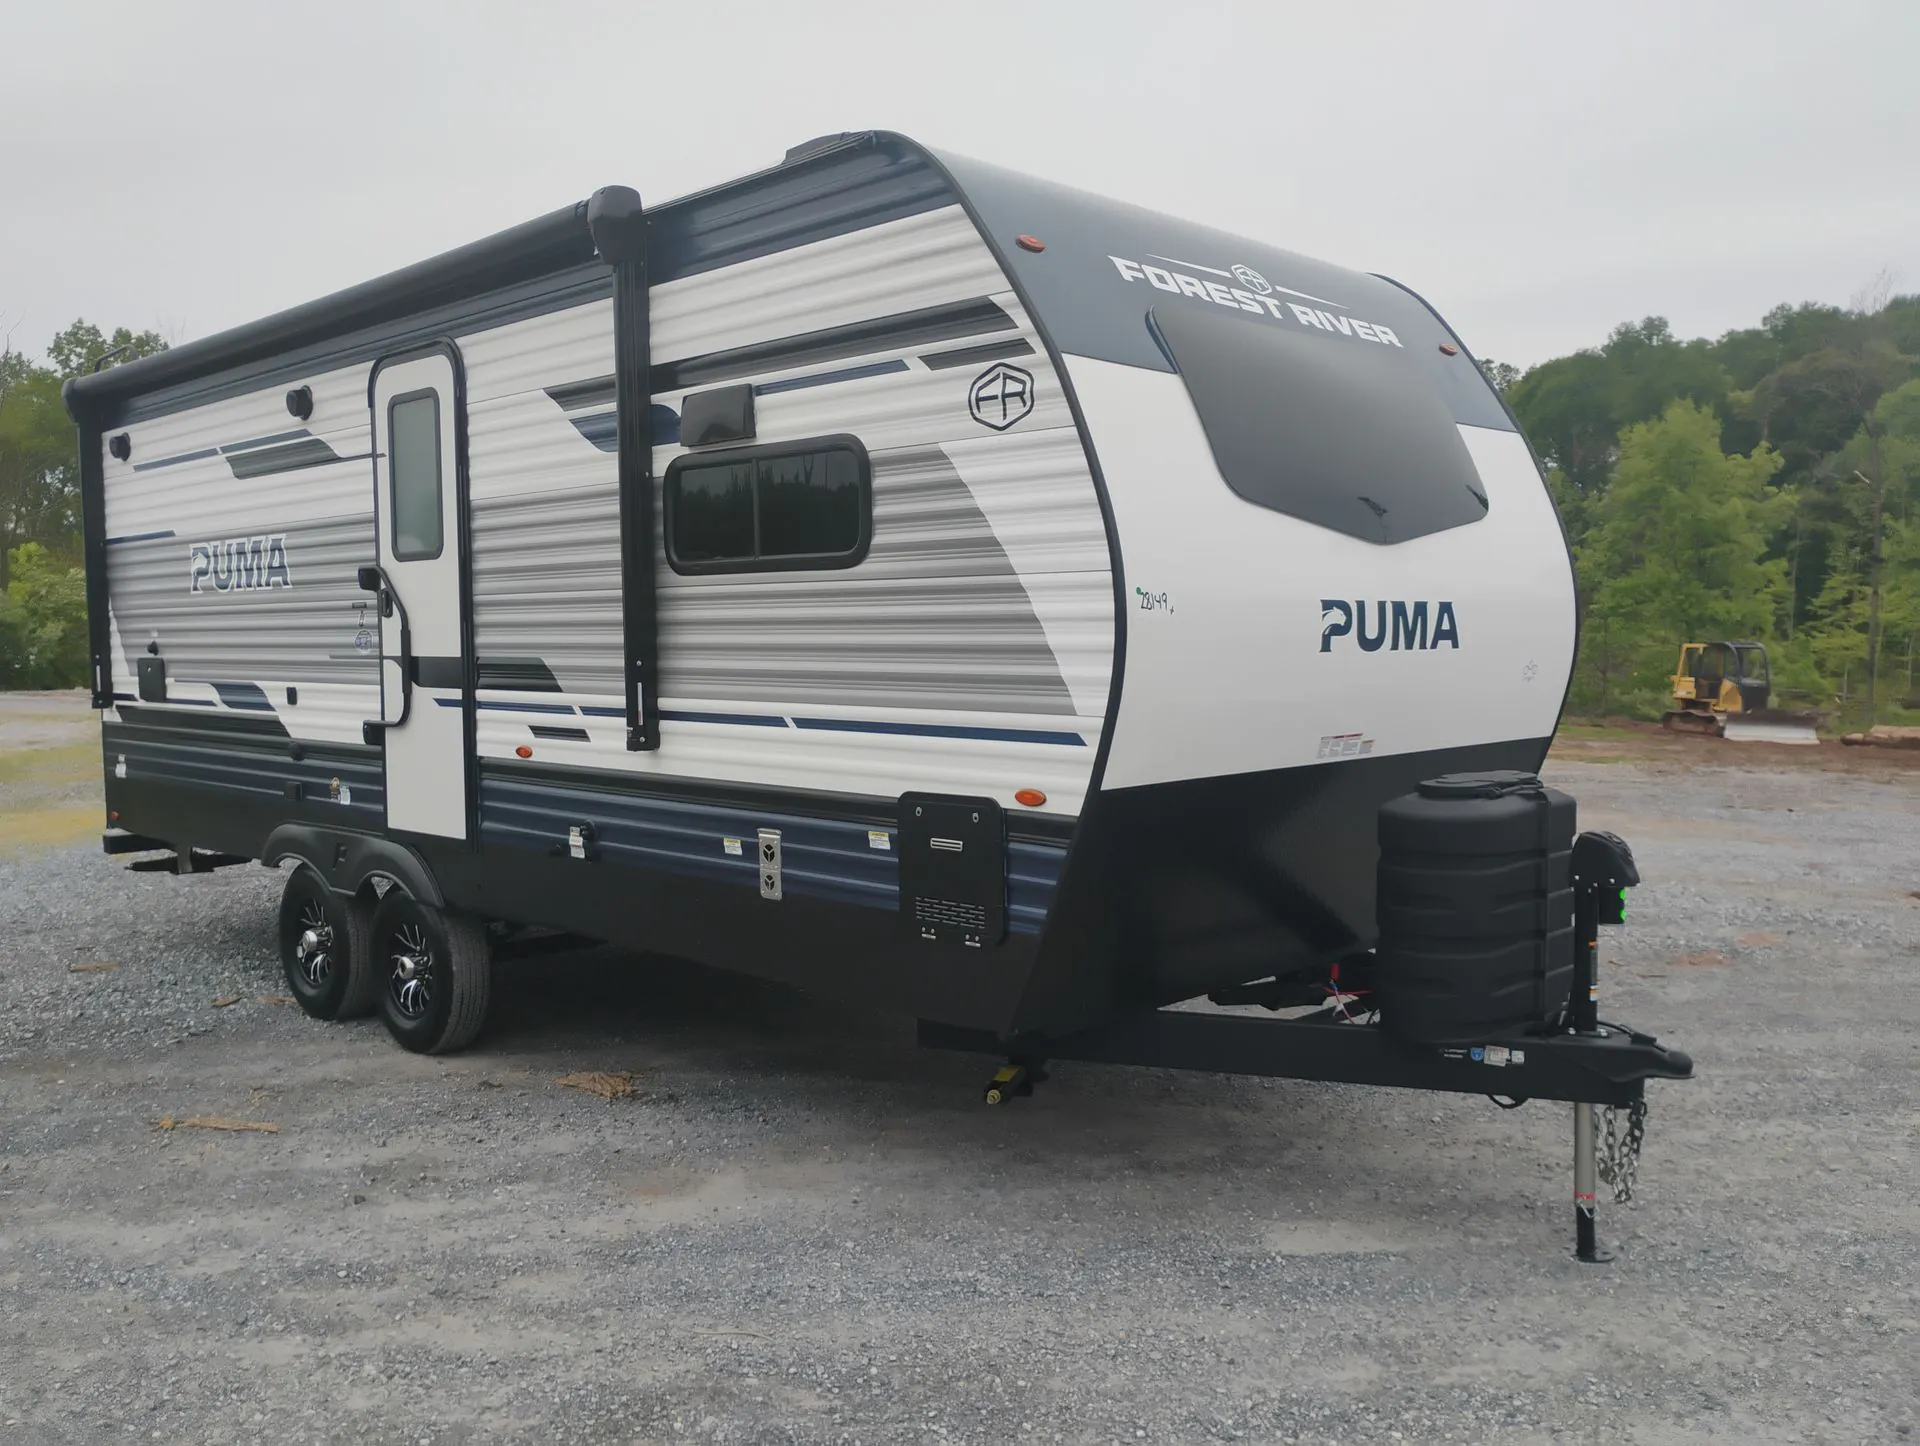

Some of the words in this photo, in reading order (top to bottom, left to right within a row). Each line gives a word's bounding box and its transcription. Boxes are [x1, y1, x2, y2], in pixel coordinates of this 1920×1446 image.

[1107, 254, 1283, 319] FOREST
[1286, 302, 1404, 348] RIVER
[189, 533, 293, 594] PUMA
[1319, 599, 1460, 653] PUMA
